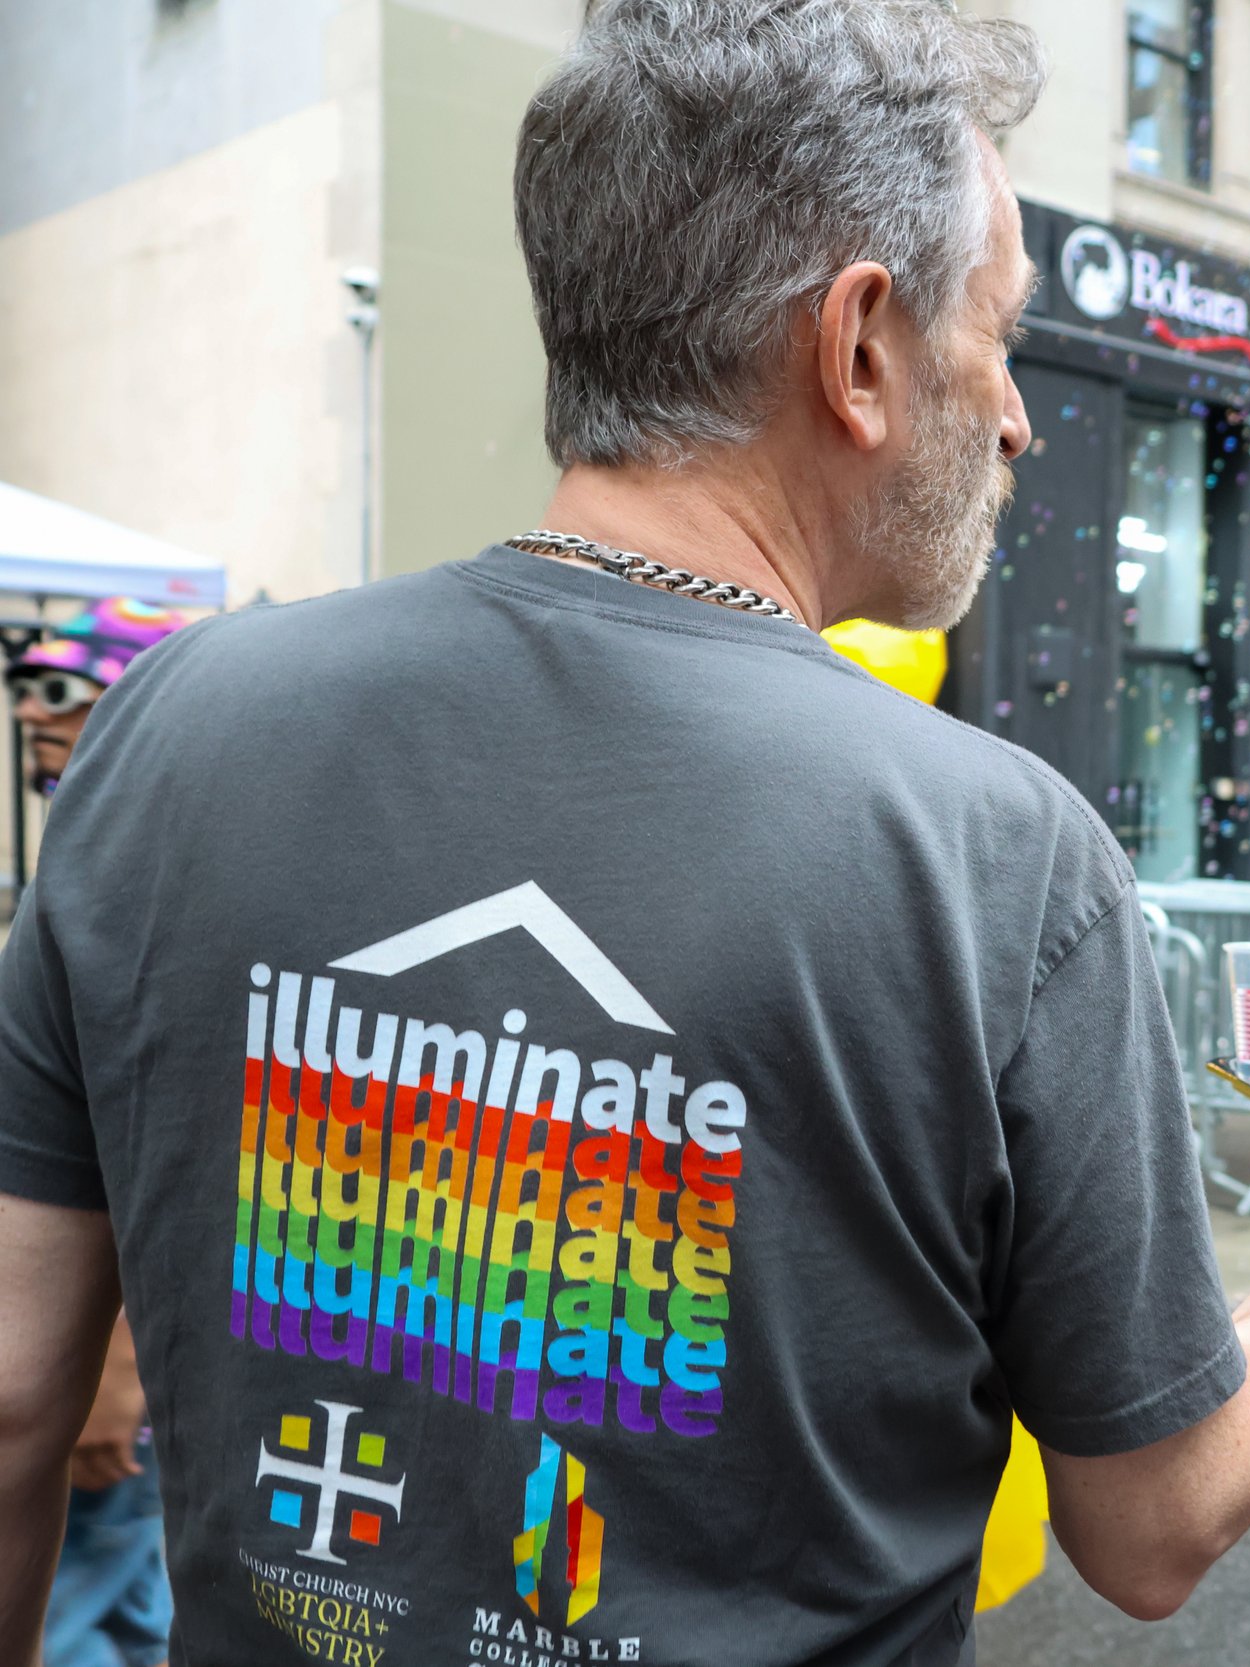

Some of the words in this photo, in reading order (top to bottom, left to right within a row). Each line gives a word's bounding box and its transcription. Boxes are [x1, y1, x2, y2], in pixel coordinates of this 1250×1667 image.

[1131, 248, 1248, 337] Bokara
[246, 960, 747, 1154] illuminate
[239, 1547, 290, 1584] CHRIST
[293, 1570, 369, 1605] CHURCH
[373, 1590, 409, 1617] NYC
[251, 1573, 389, 1637] LGBTQIA+
[256, 1599, 386, 1667] MINISTRY
[469, 1637, 581, 1667] COLLE
[472, 1606, 641, 1662] MARBLE
